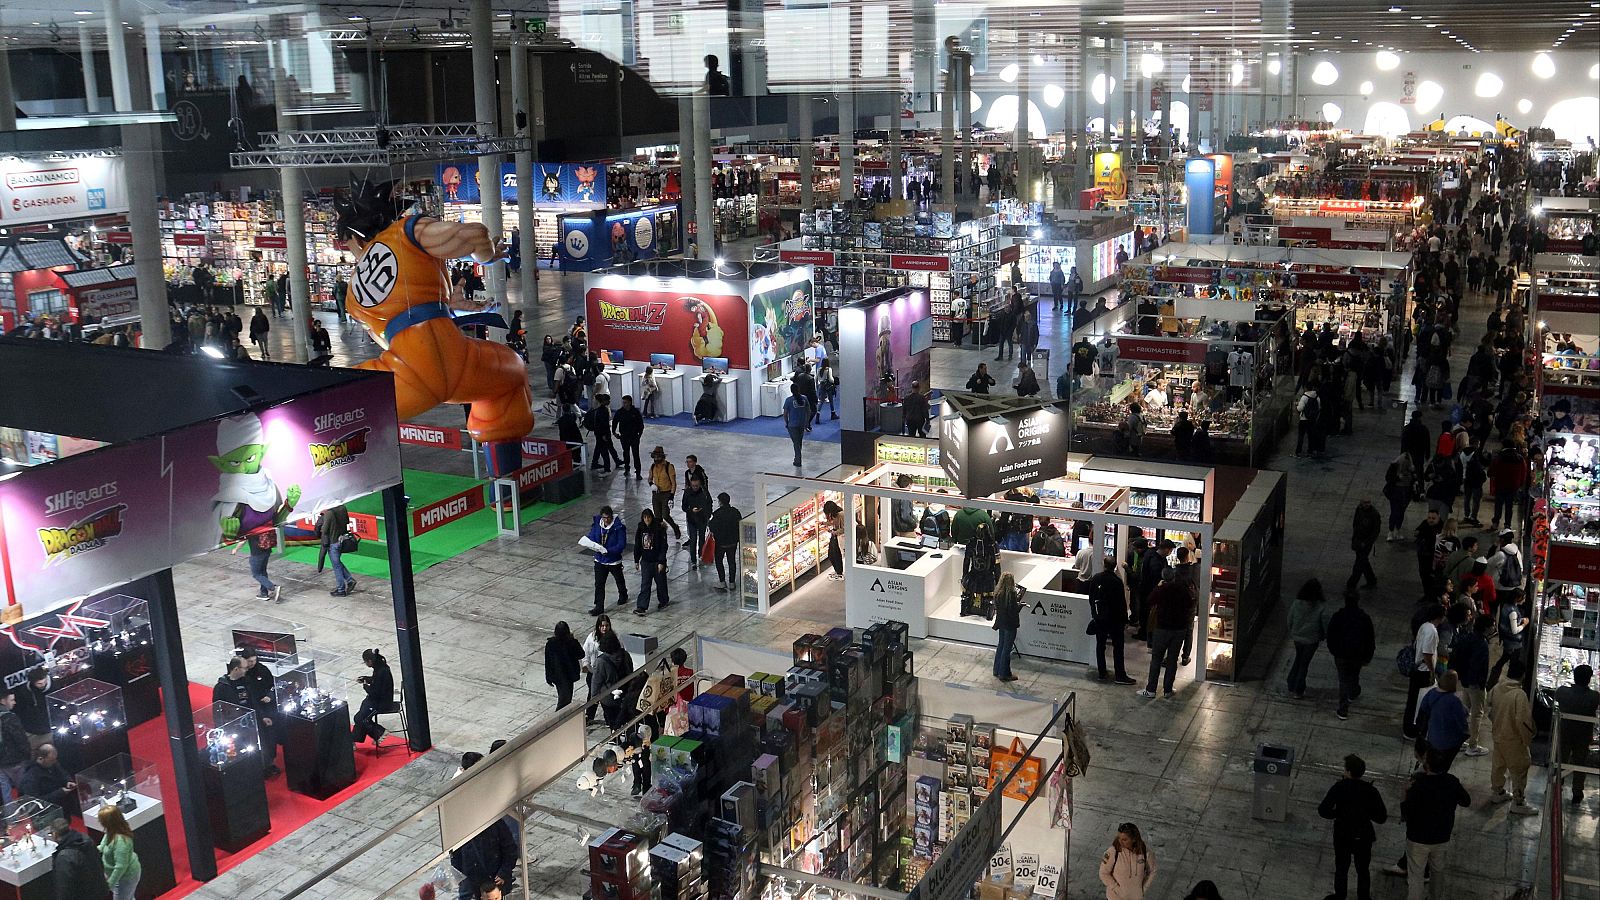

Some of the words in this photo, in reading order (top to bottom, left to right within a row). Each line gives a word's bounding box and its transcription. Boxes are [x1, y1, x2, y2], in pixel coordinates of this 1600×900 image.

[43, 172, 76, 182] NAMCO
[23, 195, 76, 208] GASHAPON
[599, 300, 630, 321] DRAGON
[646, 302, 667, 325] Z
[400, 426, 445, 443] MANGA
[1018, 424, 1050, 438] ORIGINS
[309, 441, 348, 467] DRAGON
[999, 462, 1014, 473] Asian
[1014, 461, 1028, 470] Food
[1028, 458, 1042, 466] Store
[520, 460, 558, 487] MANGA
[1001, 470, 1039, 484] asianorigins.es
[421, 496, 468, 528] MANGA
[38, 523, 95, 555] DRAGON
[991, 857, 1011, 867] 30€
[928, 857, 952, 894] blue
[1015, 867, 1037, 877] 20€
[1037, 875, 1056, 889] 10€
